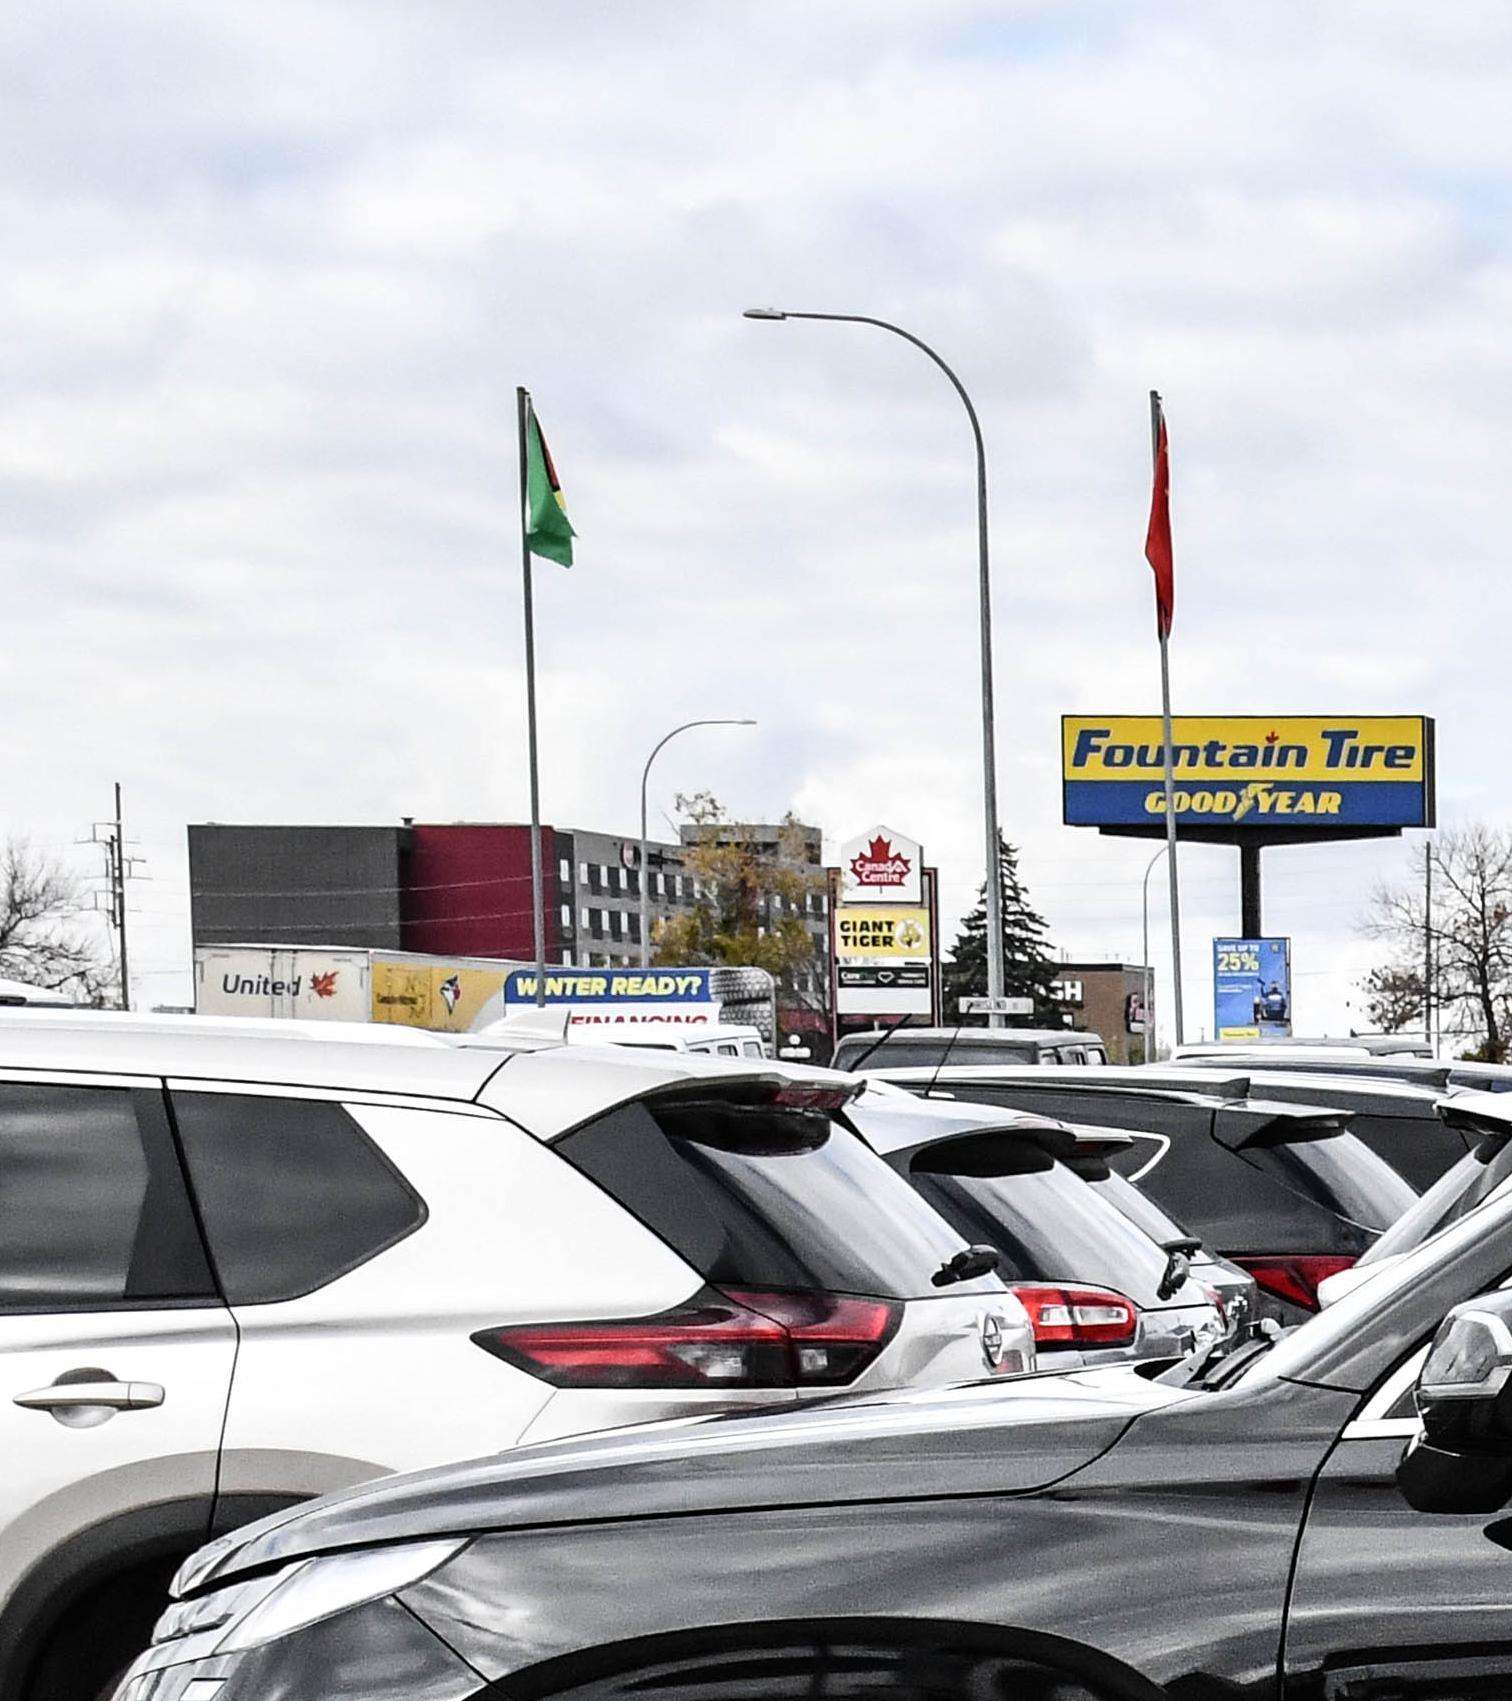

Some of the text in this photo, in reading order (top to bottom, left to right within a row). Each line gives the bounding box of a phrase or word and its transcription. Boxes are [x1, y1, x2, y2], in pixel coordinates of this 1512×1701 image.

[1072, 729, 1416, 769] Fountain Tire
[861, 870, 900, 883] Centre
[840, 921, 895, 932] GIANT
[841, 935, 893, 947] TIGER
[1218, 953, 1259, 971] 25%
[222, 973, 301, 997] United
[516, 976, 702, 996] WNTER READY?
